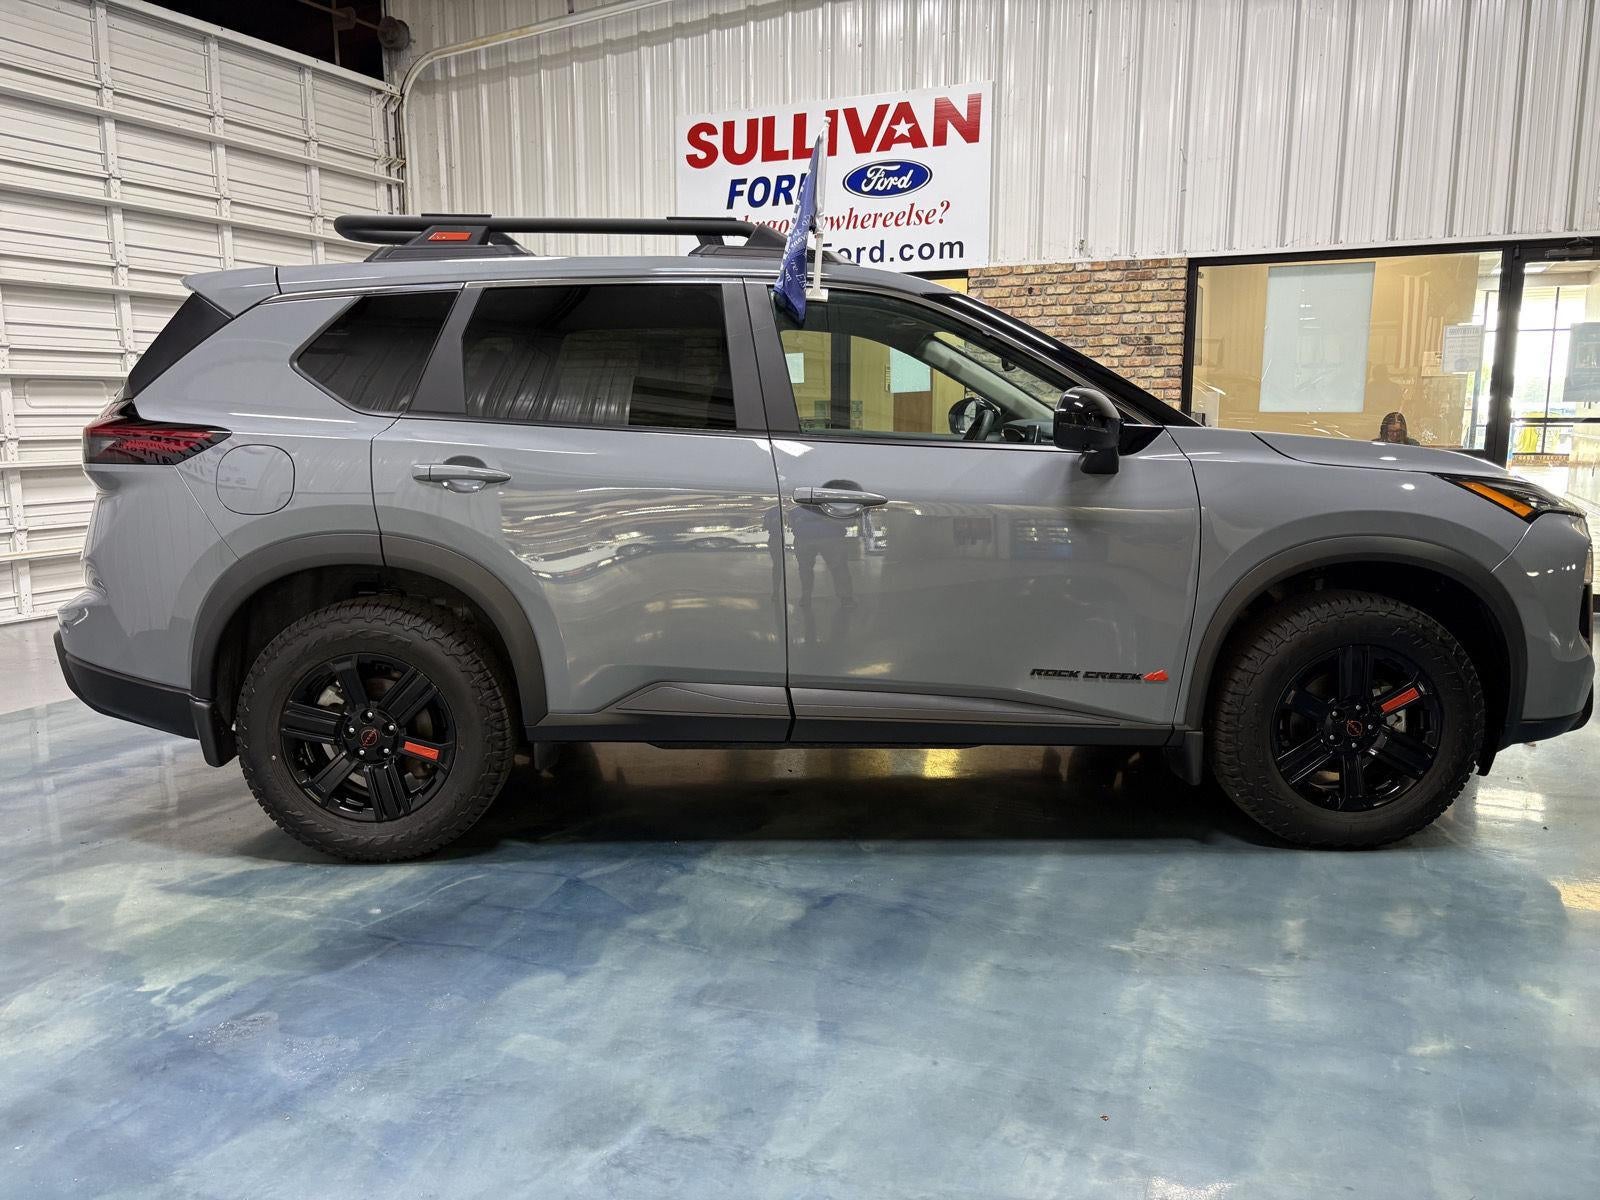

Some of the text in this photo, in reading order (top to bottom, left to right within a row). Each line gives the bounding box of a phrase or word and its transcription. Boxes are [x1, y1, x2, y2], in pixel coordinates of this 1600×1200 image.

[686, 93, 982, 169] SULLIVAN
[727, 173, 807, 210] FOR
[861, 164, 913, 192] Ford
[1030, 668, 1143, 681] ROCK CREEK
